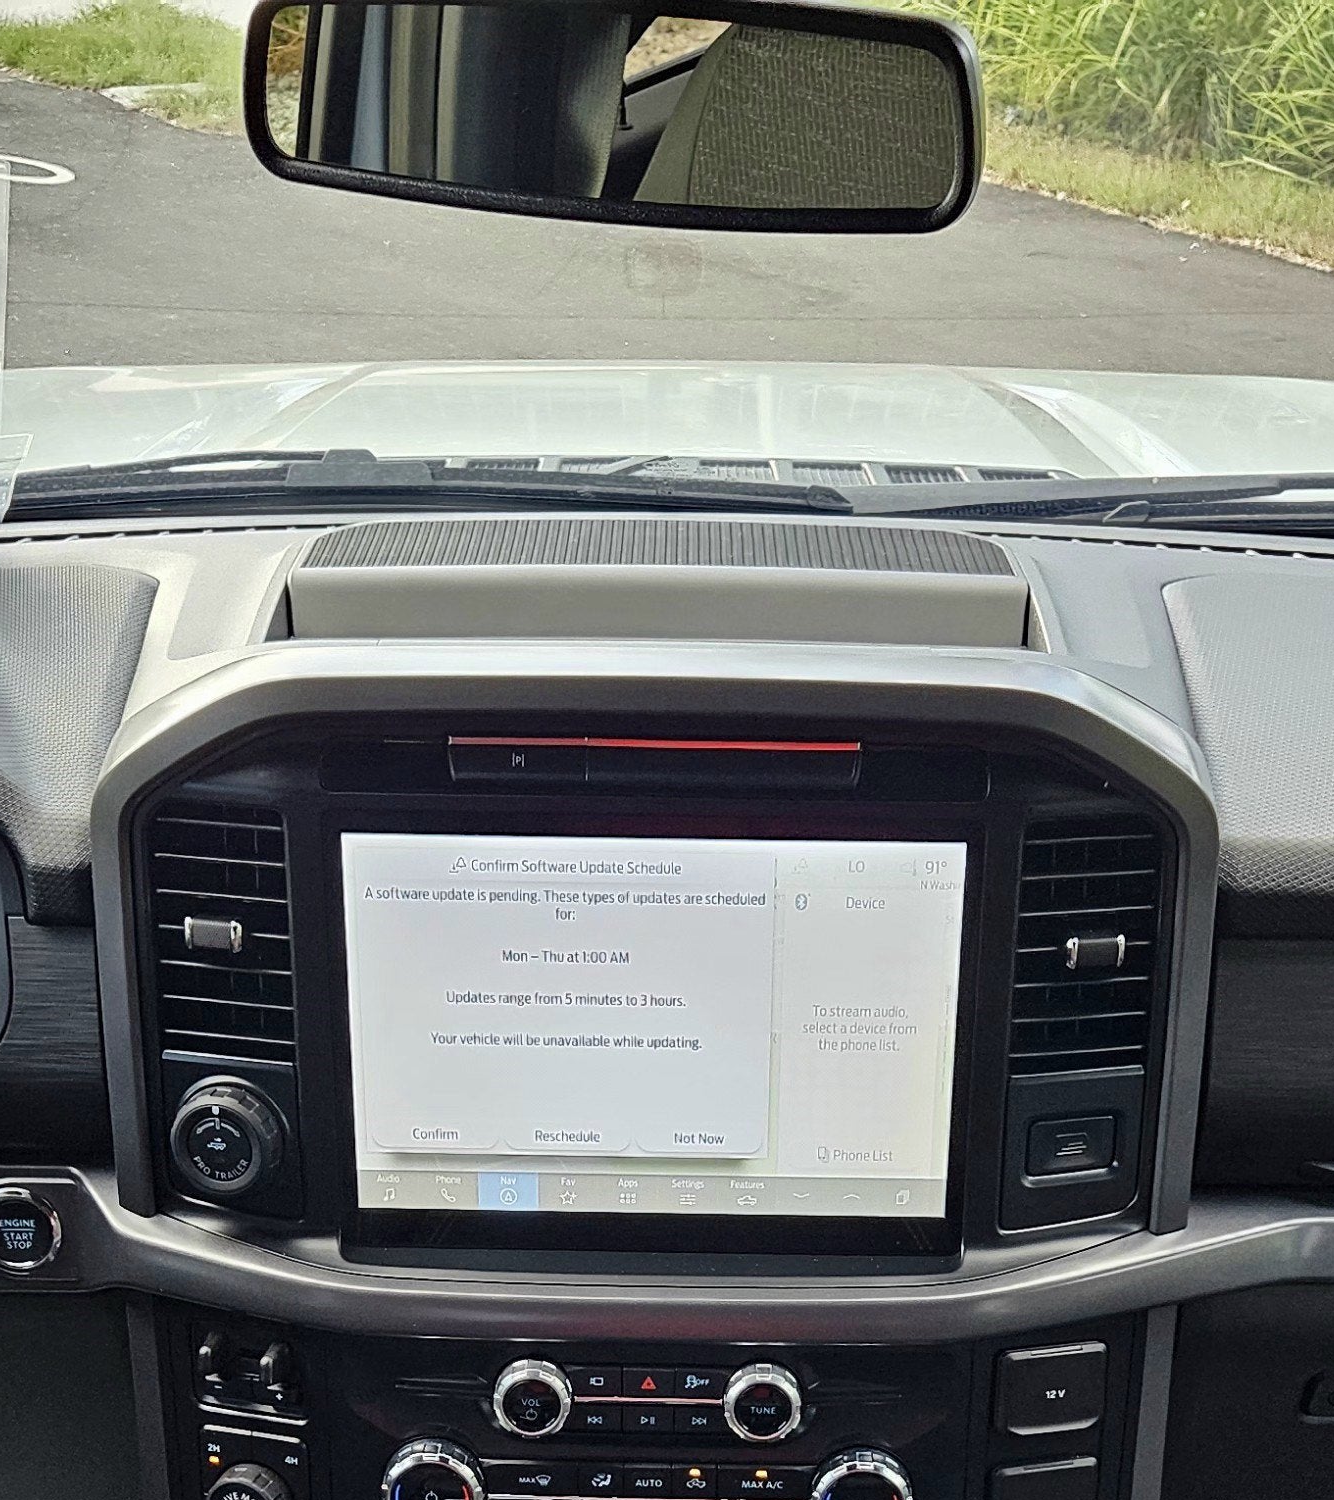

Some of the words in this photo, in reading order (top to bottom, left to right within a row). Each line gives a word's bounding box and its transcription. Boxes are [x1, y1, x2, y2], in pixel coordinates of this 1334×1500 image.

[470, 859, 519, 874] Confirm
[521, 860, 577, 874] Software
[579, 860, 624, 876] Update
[626, 861, 683, 876] Schedule
[848, 860, 866, 873] LO
[363, 886, 374, 900] A
[375, 886, 431, 901] software
[431, 887, 475, 904] update
[476, 888, 488, 902] is
[488, 888, 541, 905] pending.
[543, 889, 580, 904] These
[581, 890, 615, 907] types
[616, 890, 631, 904] of
[632, 891, 681, 907] updates
[683, 894, 703, 906] are
[704, 892, 767, 907] scheduled
[845, 896, 886, 910] Device
[554, 908, 576, 922] for:
[501, 949, 529, 964] Mon
[541, 950, 565, 964] Thu
[566, 952, 580, 964] at
[581, 950, 607, 965] 1:00
[609, 951, 630, 965] AM
[445, 990, 497, 1006] Updates
[498, 993, 532, 1008] range
[533, 992, 563, 1006] from
[565, 992, 573, 1006] 5
[574, 993, 623, 1007] minutes
[625, 994, 638, 1007] to
[640, 994, 648, 1007] 3
[649, 994, 687, 1008] hours.
[812, 1004, 828, 1018] To
[829, 1006, 872, 1018] stream
[873, 1005, 909, 1019] audio,
[802, 1021, 837, 1034] select
[840, 1024, 846, 1033] a
[848, 1022, 886, 1035] device
[888, 1022, 918, 1035] from
[429, 1031, 459, 1046] Your
[459, 1032, 501, 1046] vehicle
[502, 1032, 524, 1046] will
[525, 1033, 541, 1047] be
[542, 1033, 611, 1048] unavailable
[612, 1034, 645, 1049] while
[646, 1036, 703, 1051] updating.
[818, 1038, 838, 1051] the
[839, 1038, 877, 1053] phone
[879, 1038, 900, 1052] list.
[411, 1127, 460, 1142] Confirm
[533, 1129, 602, 1144] Reschedule
[673, 1131, 696, 1145] Not
[699, 1132, 725, 1145] Now
[832, 1148, 870, 1163] Phone
[873, 1148, 894, 1163] List
[192, 1154, 212, 1178] PRO
[214, 1157, 250, 1181] TRAILER
[377, 1174, 400, 1184] Audio
[435, 1174, 463, 1186] Phone
[500, 1175, 517, 1185] Nav
[560, 1177, 576, 1187] Fav
[617, 1177, 639, 1190] Apps
[670, 1177, 705, 1190] Settings
[729, 1179, 765, 1190] Features
[3, 1232, 34, 1241] START
[6, 1241, 33, 1250] STOP
[696, 1377, 710, 1386] OFF
[1045, 1390, 1056, 1399] 12
[1058, 1389, 1066, 1398] V
[521, 1398, 541, 1407] VOL
[750, 1406, 777, 1415] TUNE
[207, 1442, 221, 1453] 2H
[284, 1456, 298, 1465] 4H
[635, 1479, 662, 1488] AUTO
[741, 1480, 764, 1489] MAX
[765, 1479, 784, 1490] A/C
